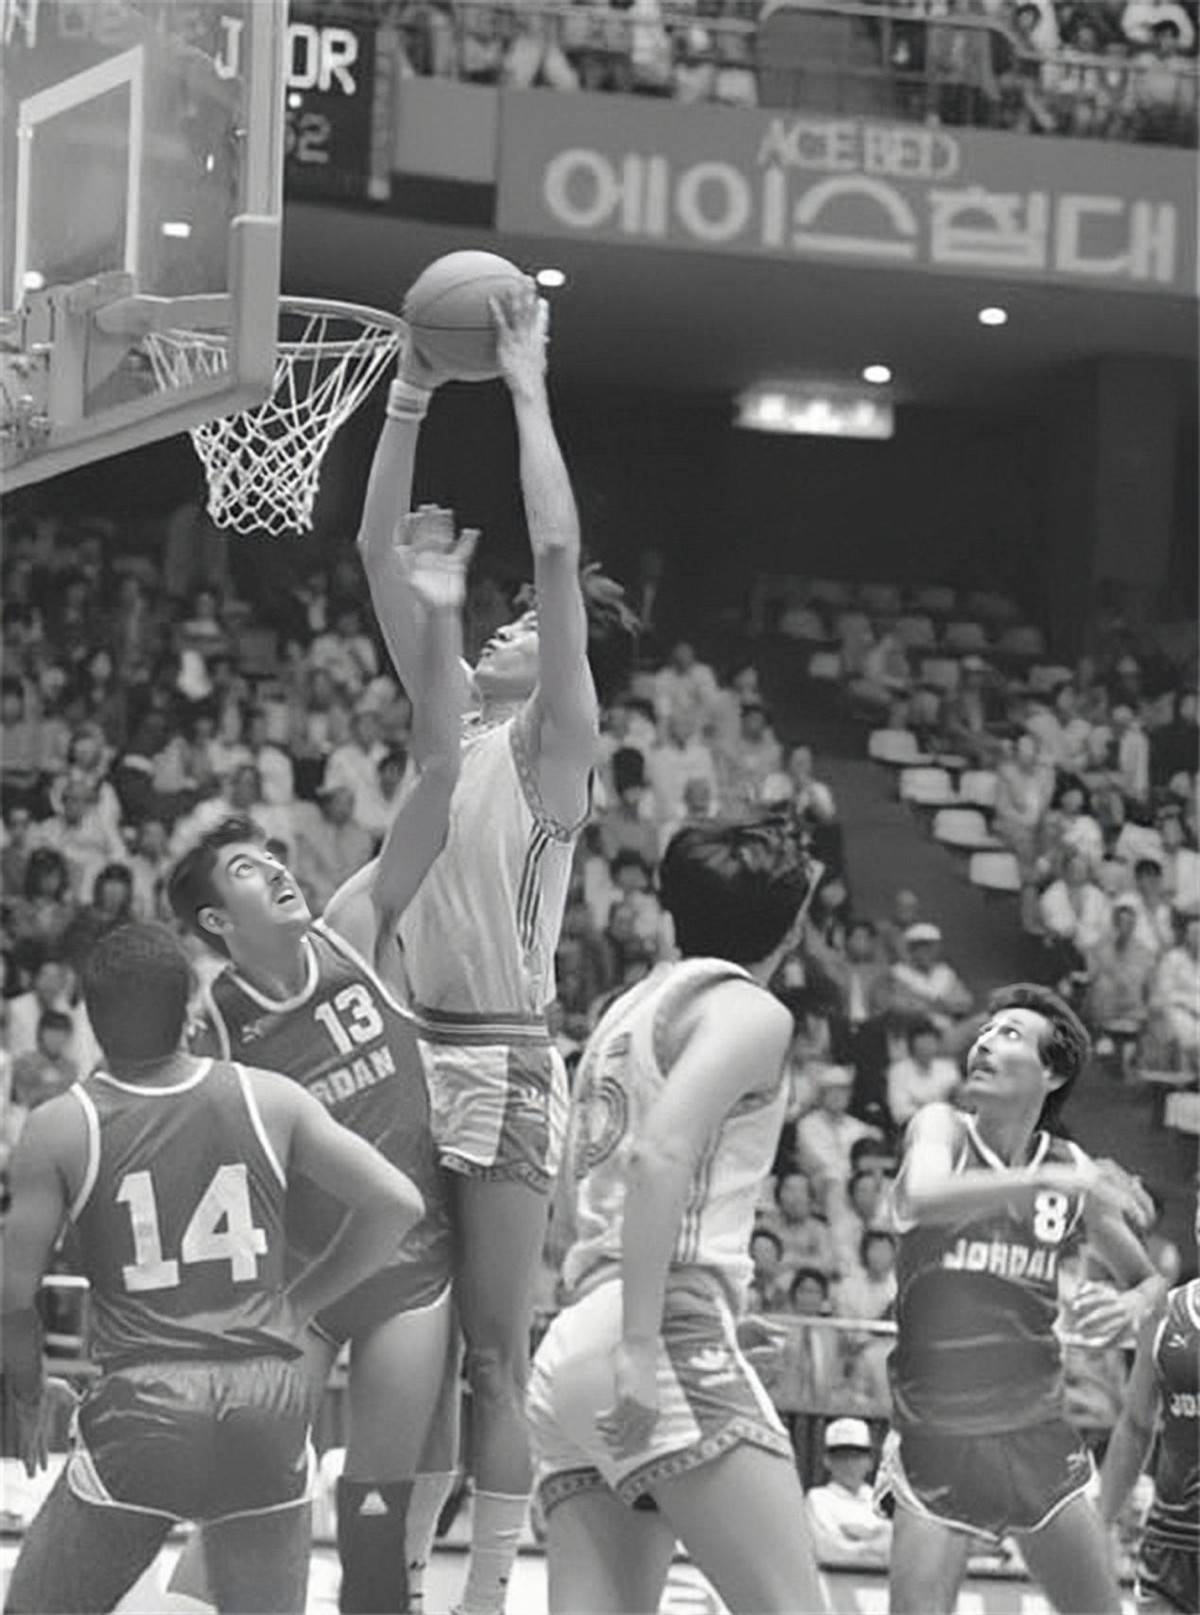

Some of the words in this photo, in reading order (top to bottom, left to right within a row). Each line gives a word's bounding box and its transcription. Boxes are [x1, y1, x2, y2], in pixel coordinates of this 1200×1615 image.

[757, 118, 859, 169] ACE
[543, 147, 1178, 283] 에이스침대
[313, 982, 385, 1056] 13
[308, 1045, 397, 1105] RDAN
[115, 1162, 268, 1293] 14
[1032, 1190, 1069, 1244] 8
[1169, 1391, 1200, 1418] JO
